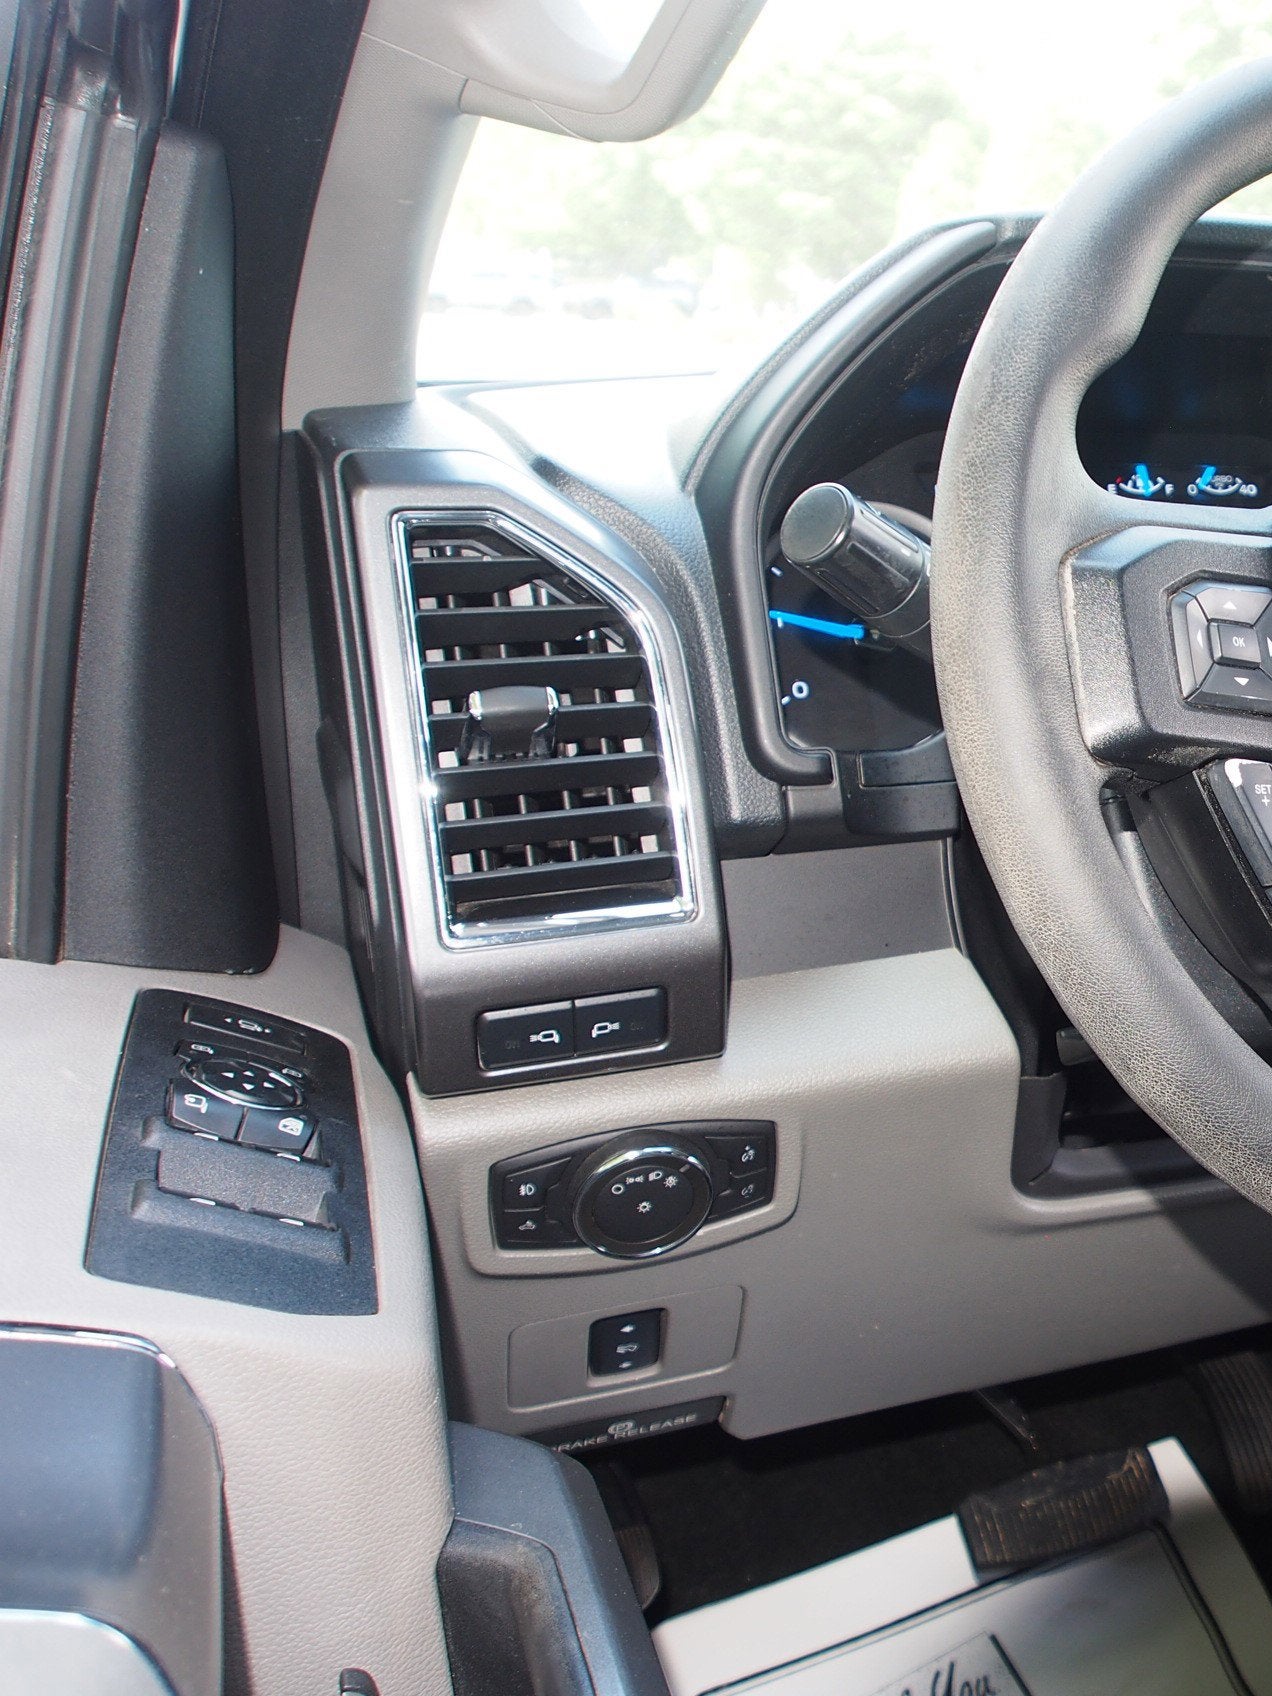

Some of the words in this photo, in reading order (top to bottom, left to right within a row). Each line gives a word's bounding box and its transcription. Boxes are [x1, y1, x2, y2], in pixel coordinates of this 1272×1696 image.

[1239, 484, 1258, 497] 40
[1232, 635, 1246, 648] OK
[1254, 783, 1272, 795] SET
[553, 1434, 609, 1453] RAKE
[613, 1413, 697, 1440] RELEASE
